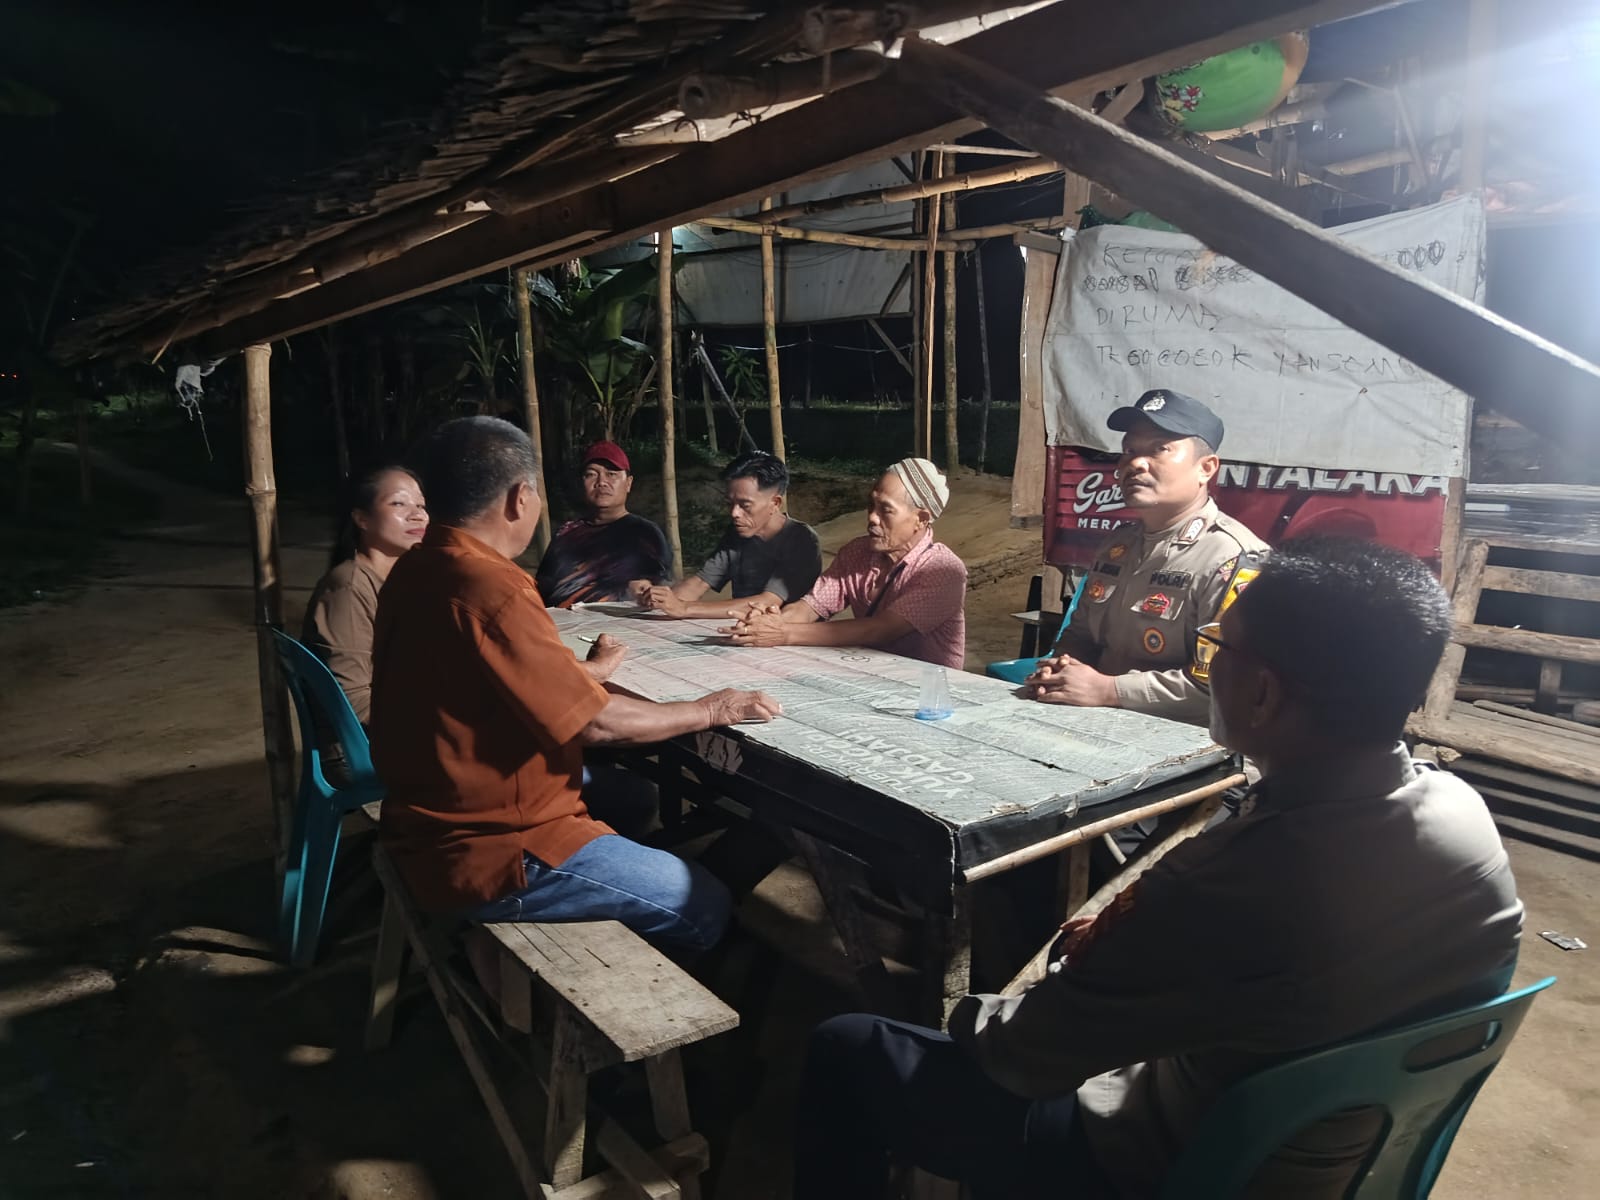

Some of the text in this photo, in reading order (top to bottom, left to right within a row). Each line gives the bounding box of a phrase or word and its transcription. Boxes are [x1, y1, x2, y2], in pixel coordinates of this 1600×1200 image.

[1077, 518, 1130, 531] MERA
[795, 729, 964, 797] YUK NGOPI
[798, 743, 913, 793] TUBRUKERS
